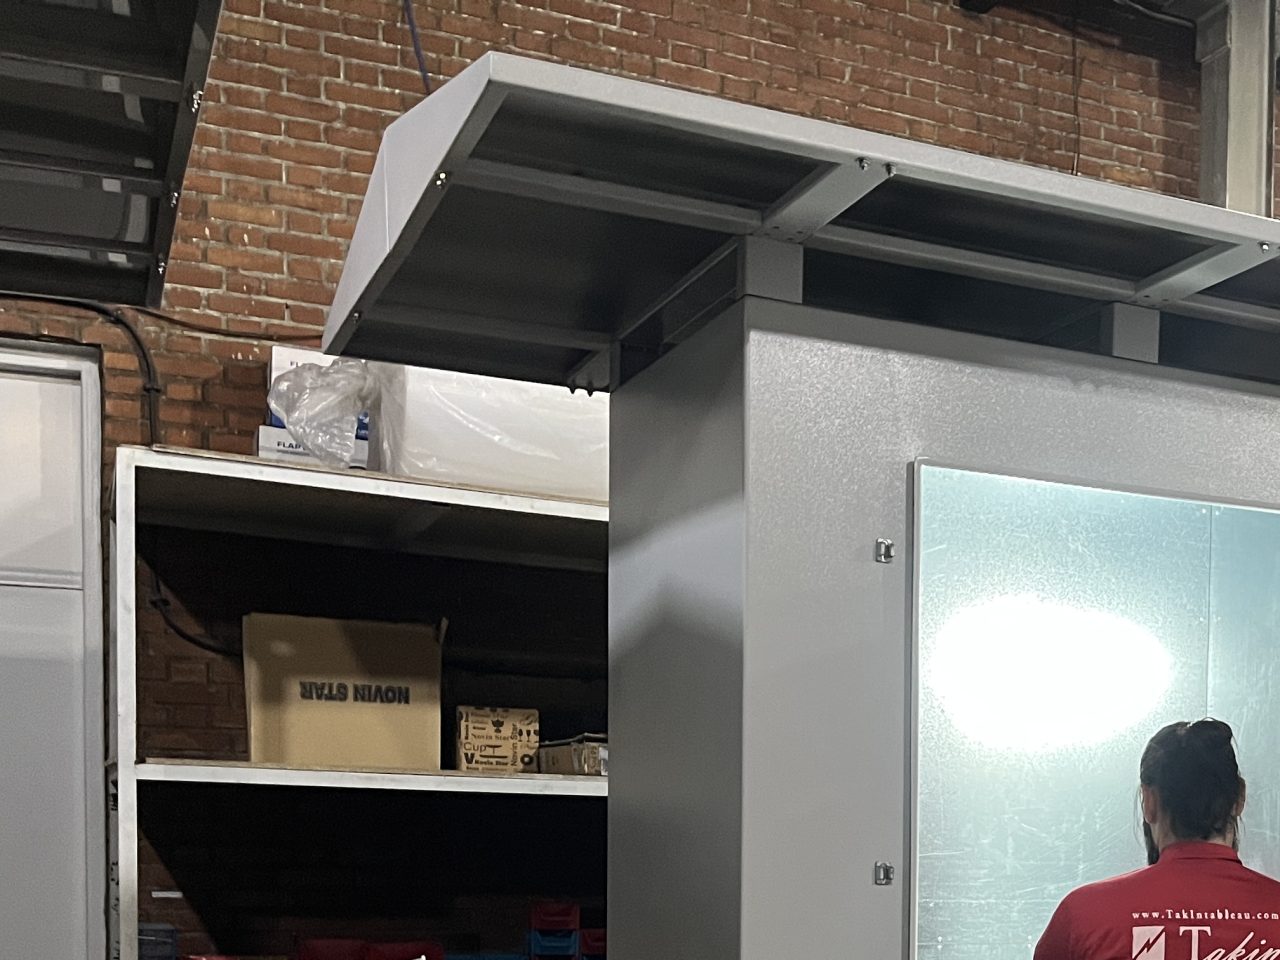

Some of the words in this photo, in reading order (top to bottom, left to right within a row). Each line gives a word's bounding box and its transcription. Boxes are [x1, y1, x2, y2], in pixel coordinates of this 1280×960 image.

[299, 681, 348, 702] STAR
[353, 683, 410, 705] NOVIN
[463, 742, 486, 753] Cup
